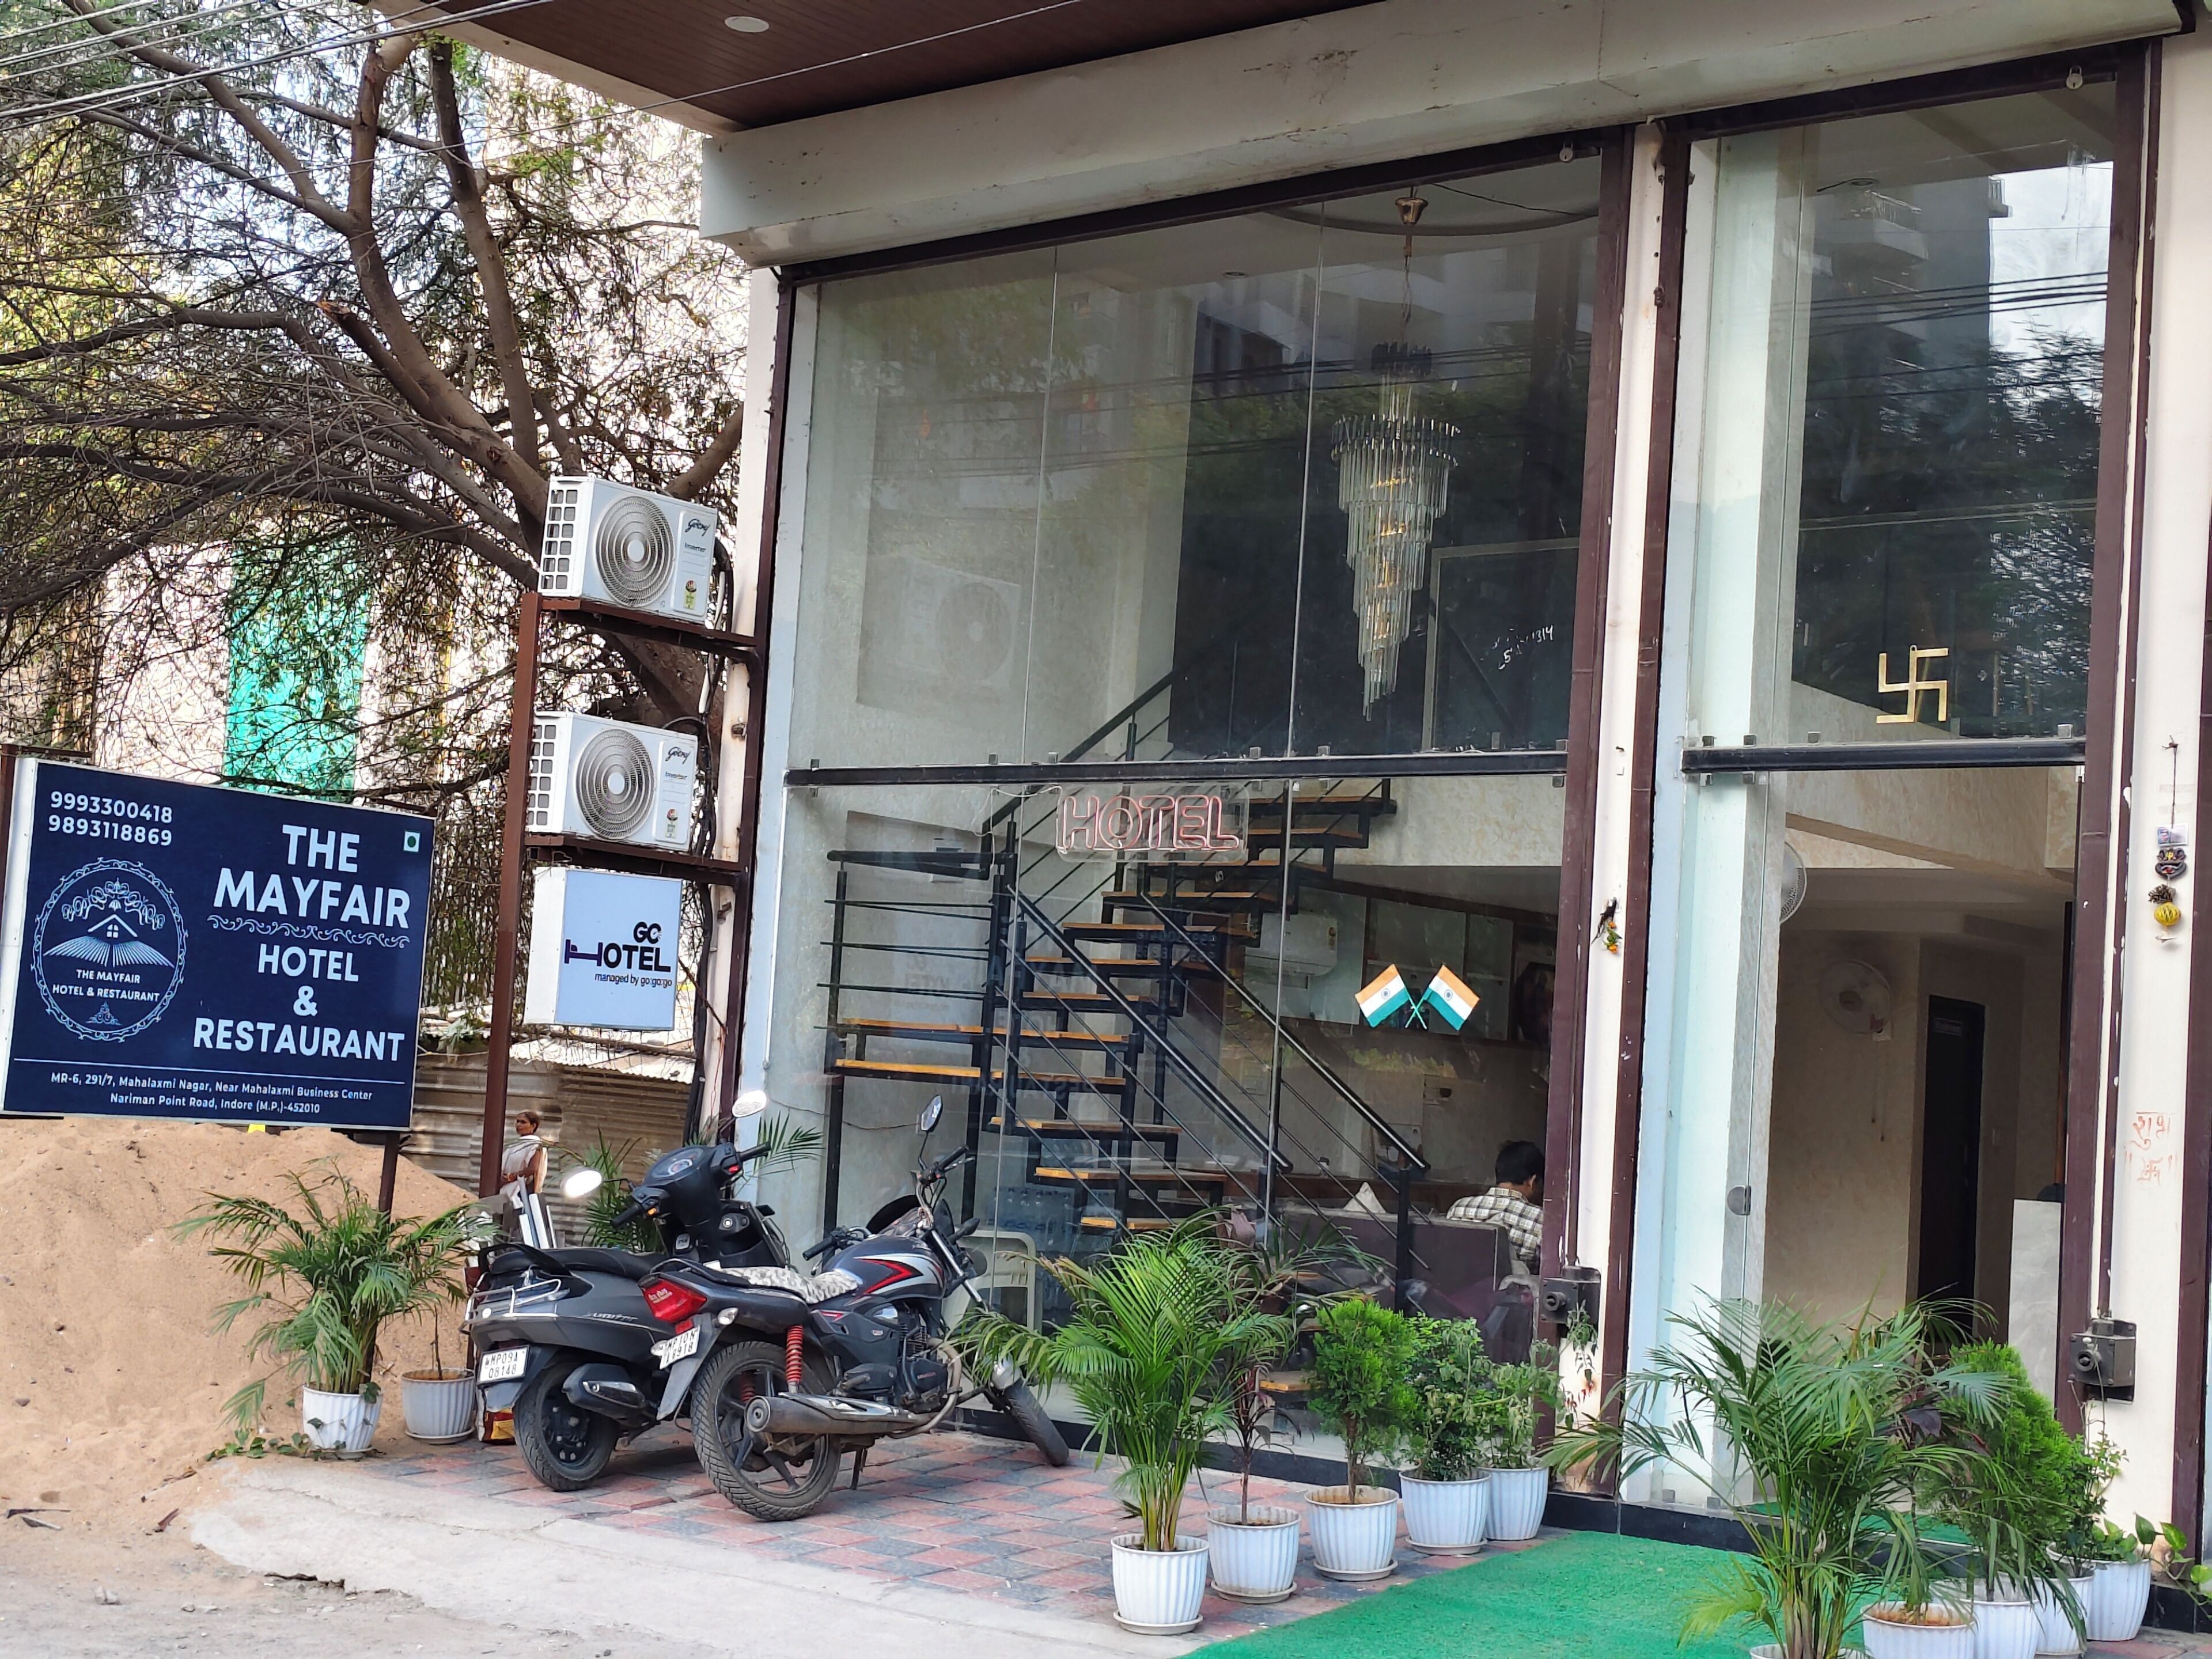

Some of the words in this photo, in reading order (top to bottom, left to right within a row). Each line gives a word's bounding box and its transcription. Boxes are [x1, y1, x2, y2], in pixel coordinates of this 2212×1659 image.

[51, 791, 172, 823] 9993300418
[1062, 795, 1239, 850] HOTEL
[48, 815, 172, 846] 9893118869
[282, 824, 360, 873] THE
[213, 868, 410, 929] MAYFAIR
[257, 944, 359, 982] HOTEL
[565, 939, 671, 972] HOTEL
[76, 969, 94, 980] THE
[96, 971, 140, 983] MAYFAIR
[594, 974, 629, 984] managed
[630, 974, 639, 986] by
[52, 984, 84, 996] HOTEL
[86, 987, 94, 997] &
[97, 988, 160, 1002] RESTAURANT
[293, 985, 318, 1017] &
[194, 1017, 405, 1062] RESTAURANT
[51, 1073, 81, 1085] MR-6,
[85, 1073, 115, 1087] 291/7,
[119, 1076, 176, 1089] Mahalaxmi
[179, 1079, 211, 1093] Nagar,
[215, 1081, 238, 1092] Near
[242, 1083, 294, 1096] Mahalaxmi
[297, 1086, 339, 1099] Business
[342, 1089, 373, 1100] Center
[111, 1093, 155, 1105] Nariman
[158, 1095, 185, 1107] Point
[190, 1097, 217, 1109] Road,
[221, 1099, 252, 1110] Indore
[256, 1100, 320, 1113] (M.P.)-452010
